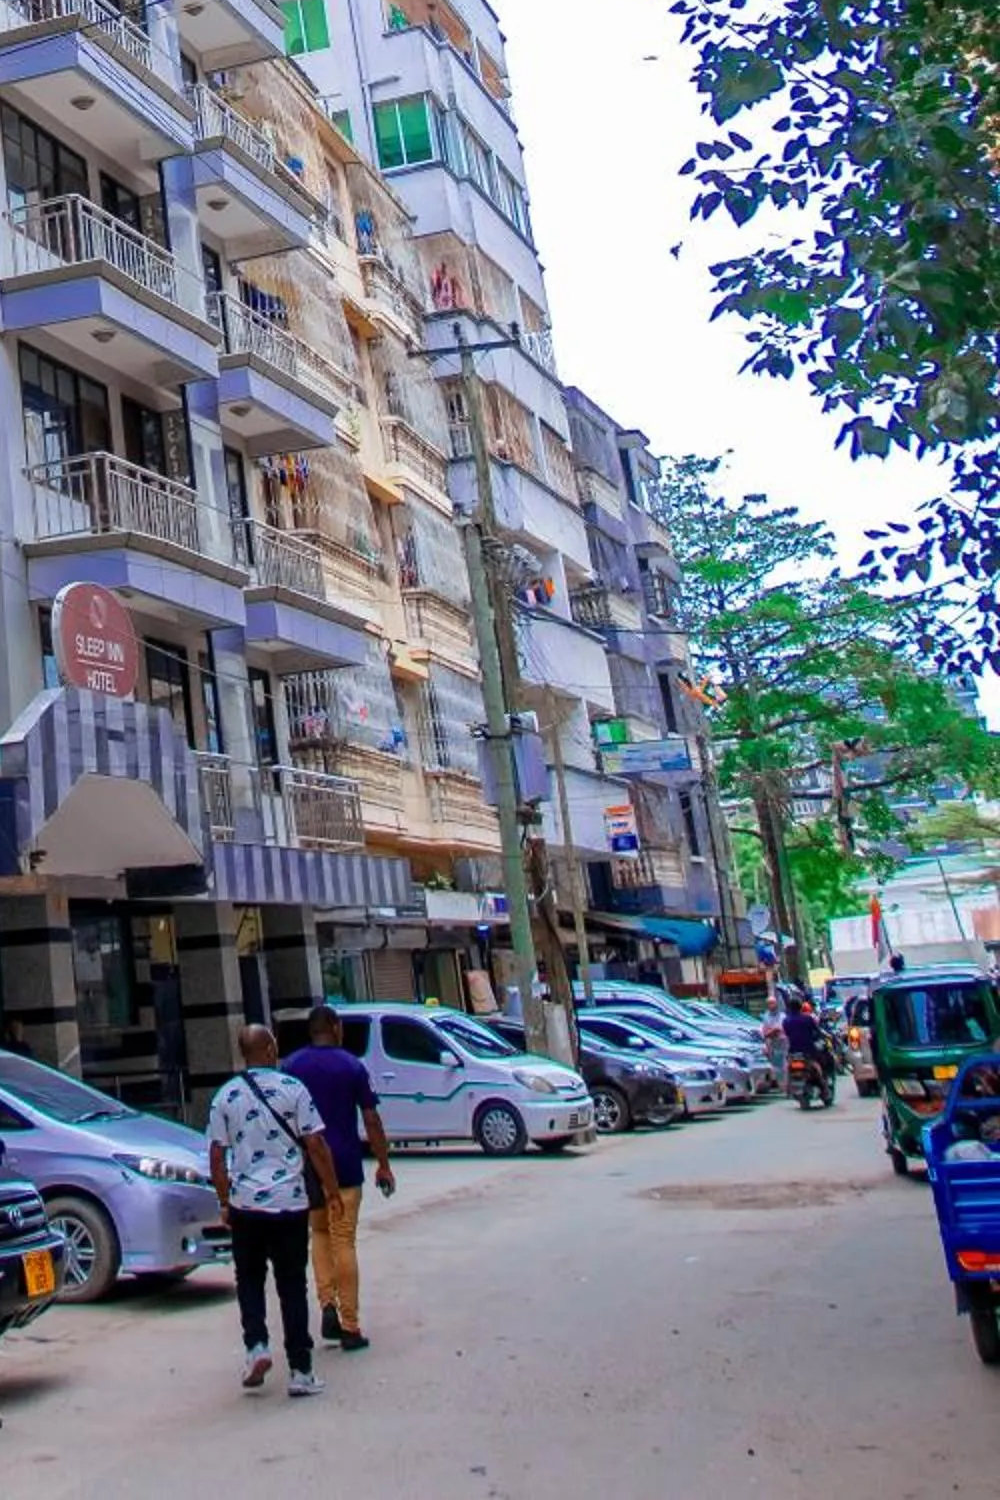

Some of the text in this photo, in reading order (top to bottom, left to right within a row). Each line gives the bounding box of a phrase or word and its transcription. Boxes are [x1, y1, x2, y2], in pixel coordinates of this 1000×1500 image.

[75, 633, 125, 662] SLEEP INN
[87, 669, 117, 693] HOTEL
